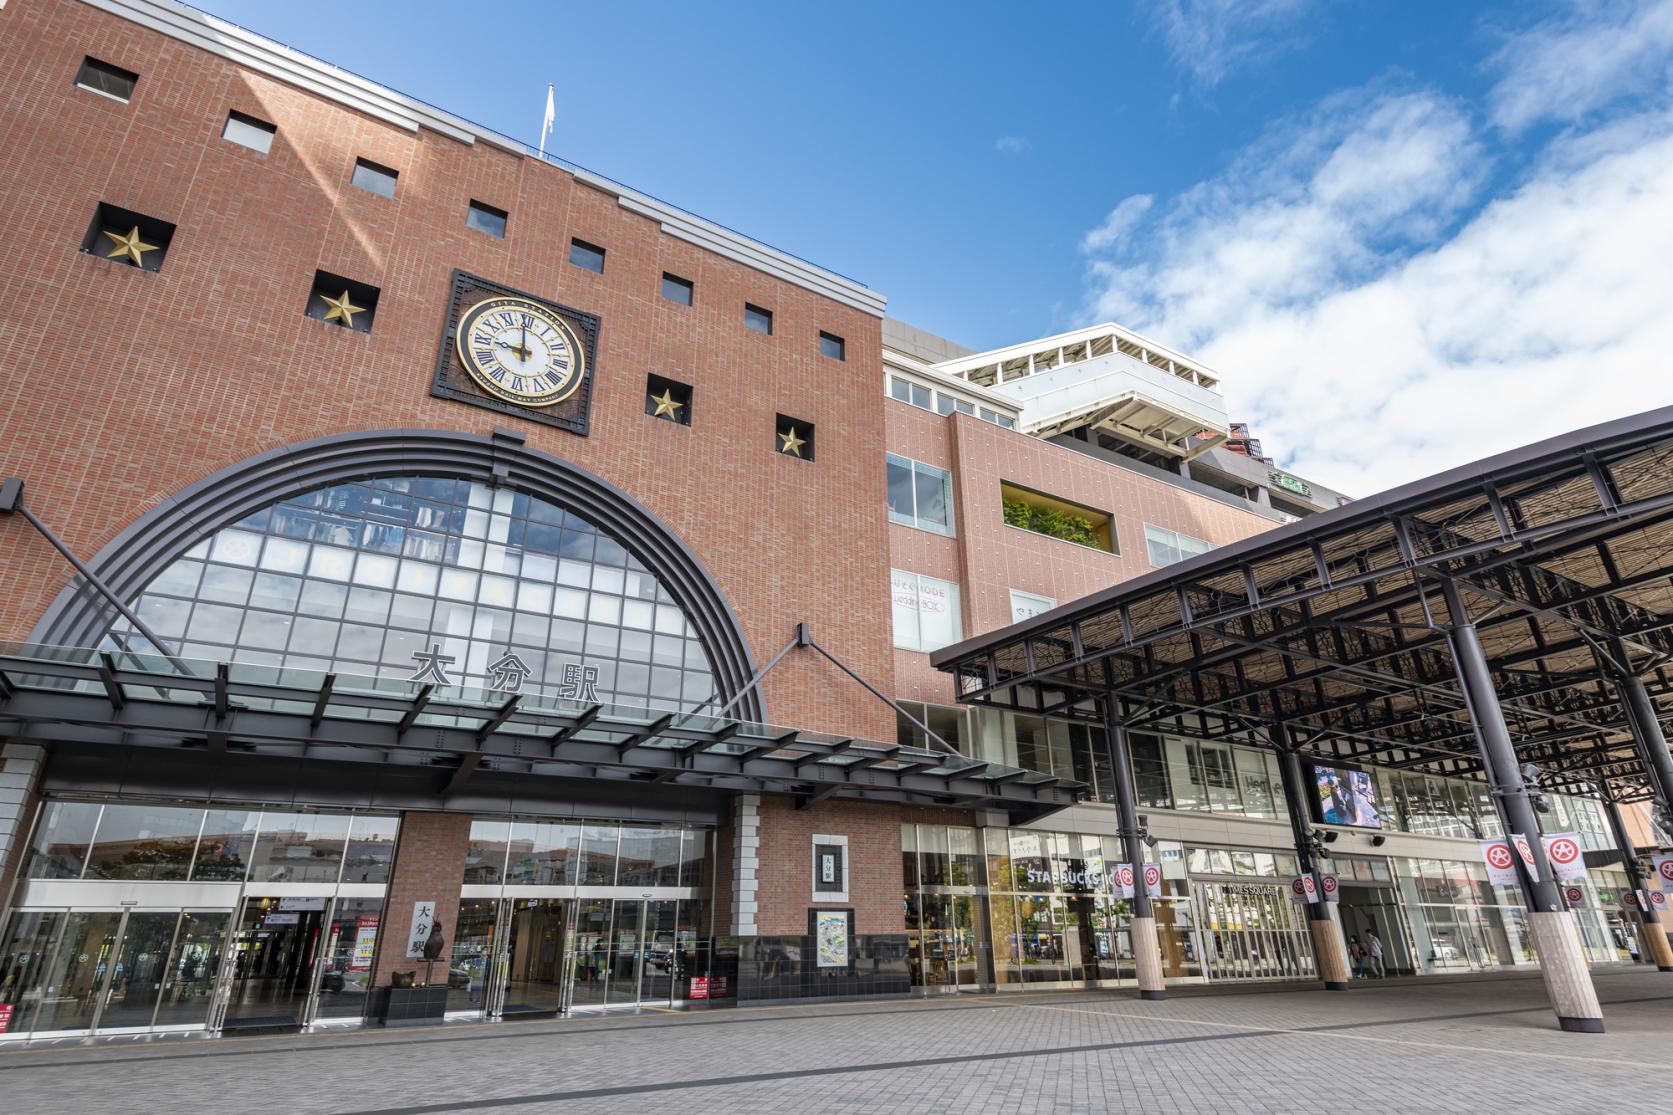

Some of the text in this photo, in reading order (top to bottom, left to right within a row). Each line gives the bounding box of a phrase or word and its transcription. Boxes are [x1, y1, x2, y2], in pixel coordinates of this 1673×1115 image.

[408, 643, 601, 703] 大分駅
[1027, 870, 1099, 886] STARBUCKS
[410, 905, 431, 953] 大分駅
